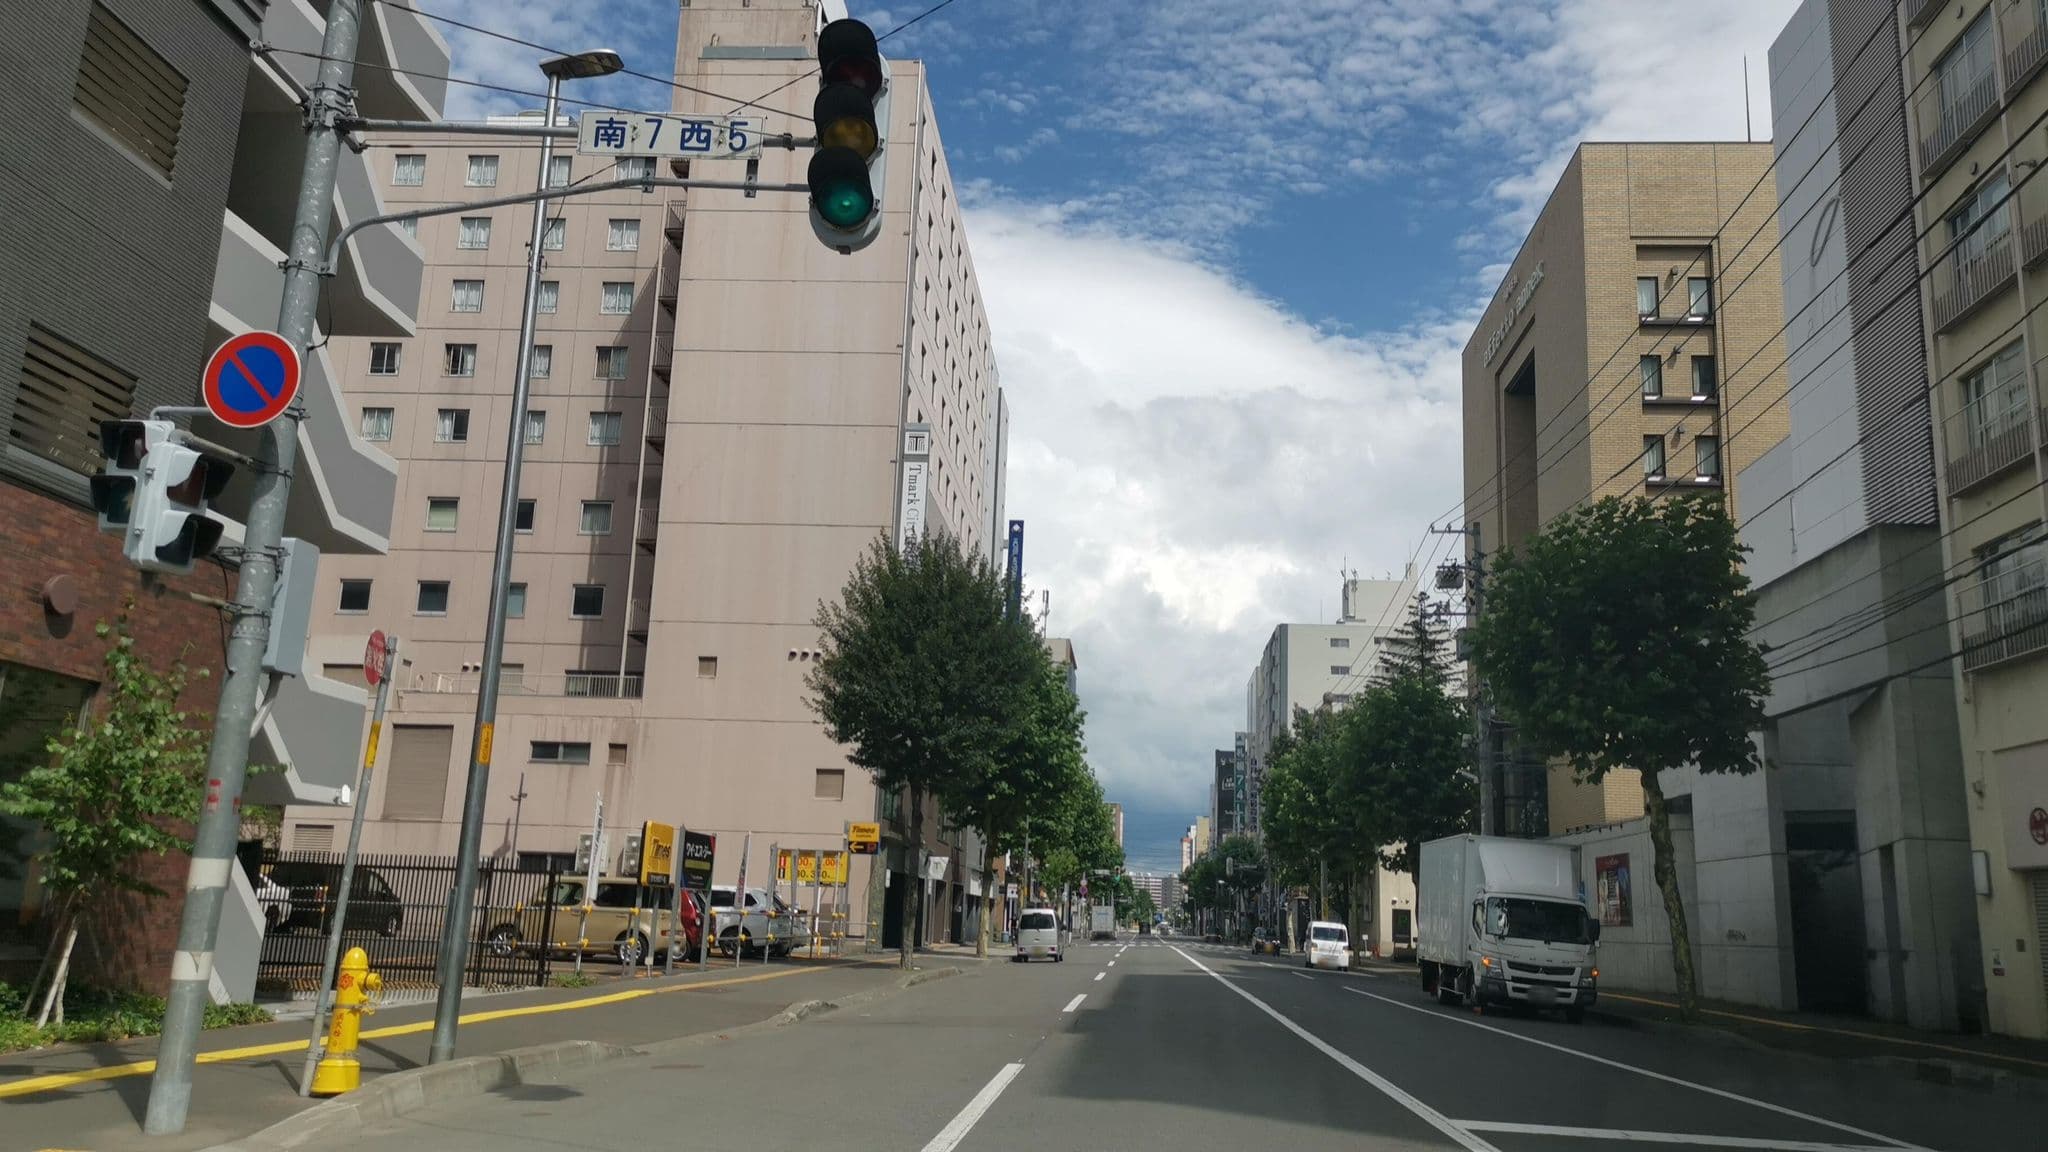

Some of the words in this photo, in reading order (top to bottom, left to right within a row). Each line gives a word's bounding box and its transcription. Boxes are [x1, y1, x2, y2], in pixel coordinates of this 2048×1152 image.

[594, 117, 749, 152] 南7西5
[908, 464, 922, 505] Tmark
[651, 837, 671, 858] Times
